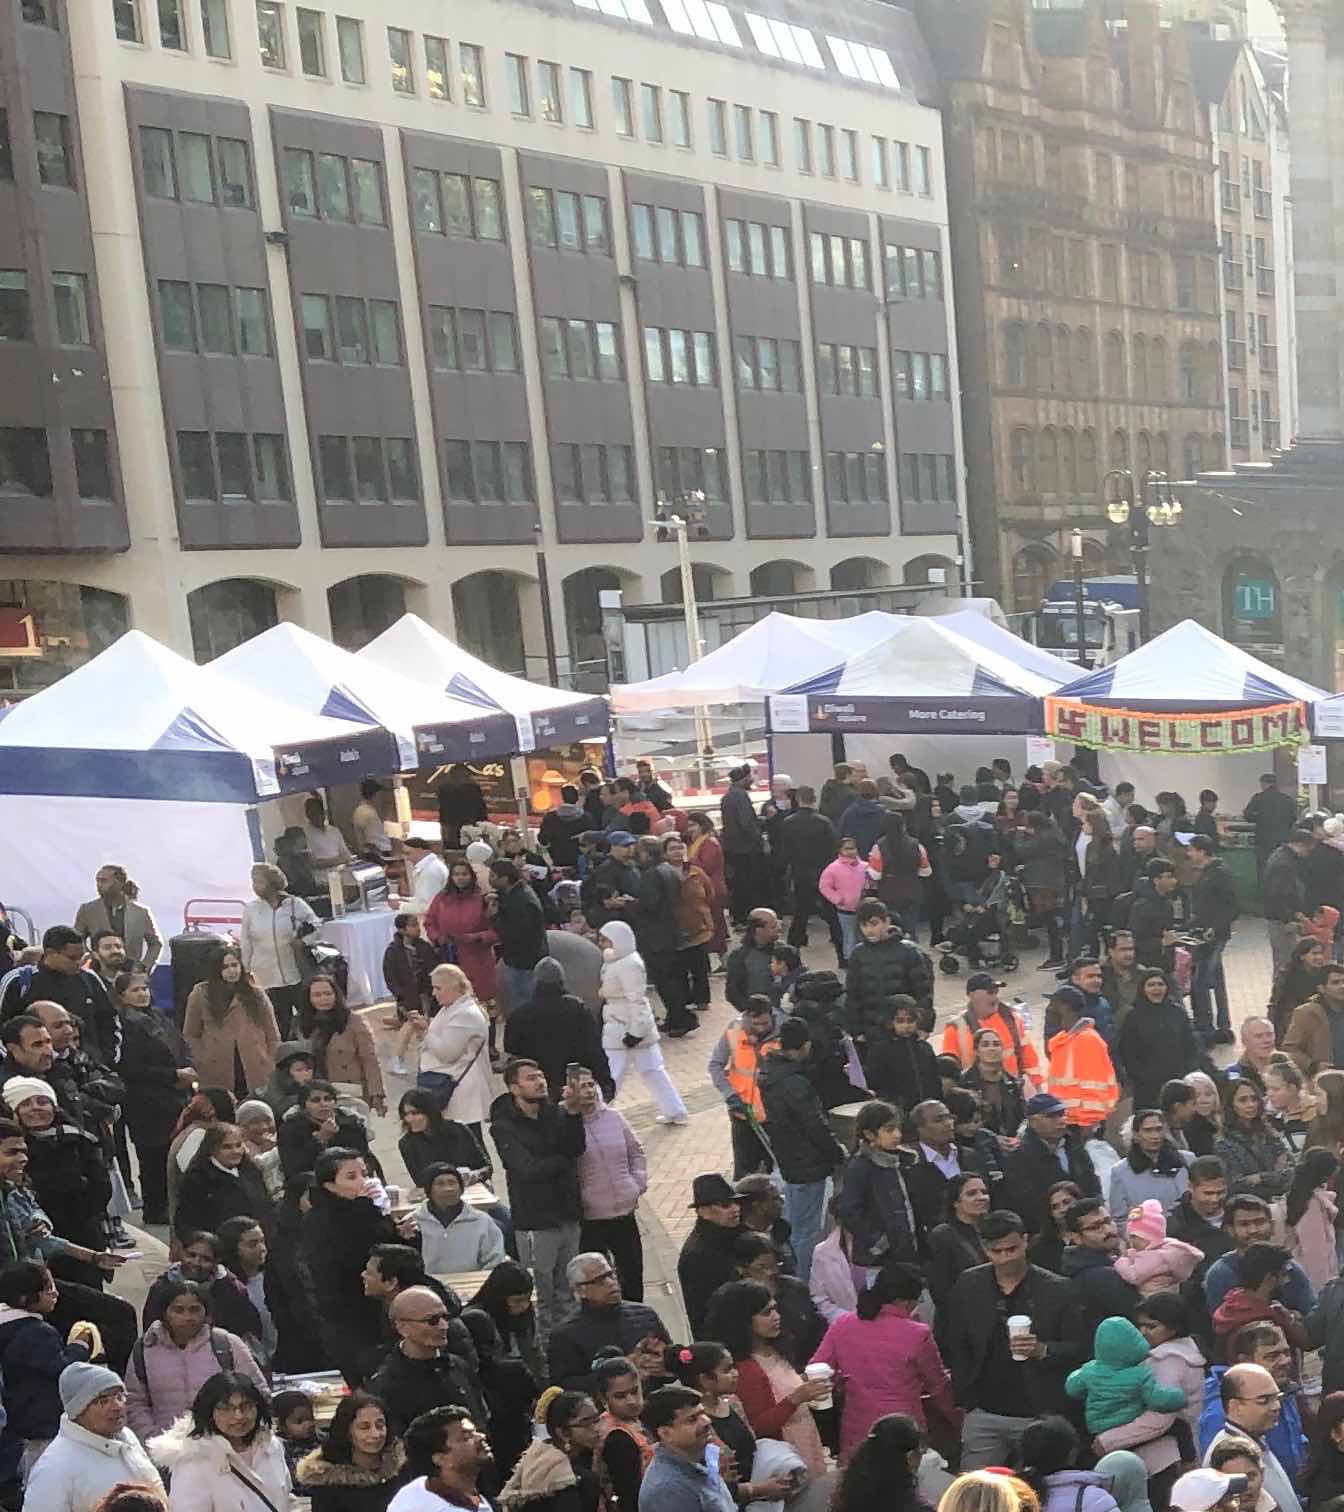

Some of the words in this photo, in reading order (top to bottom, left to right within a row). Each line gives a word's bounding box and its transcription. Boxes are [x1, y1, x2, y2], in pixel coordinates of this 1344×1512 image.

[909, 709, 938, 720] More
[938, 709, 986, 722] Catering
[1101, 709, 1300, 748] WELCOM
